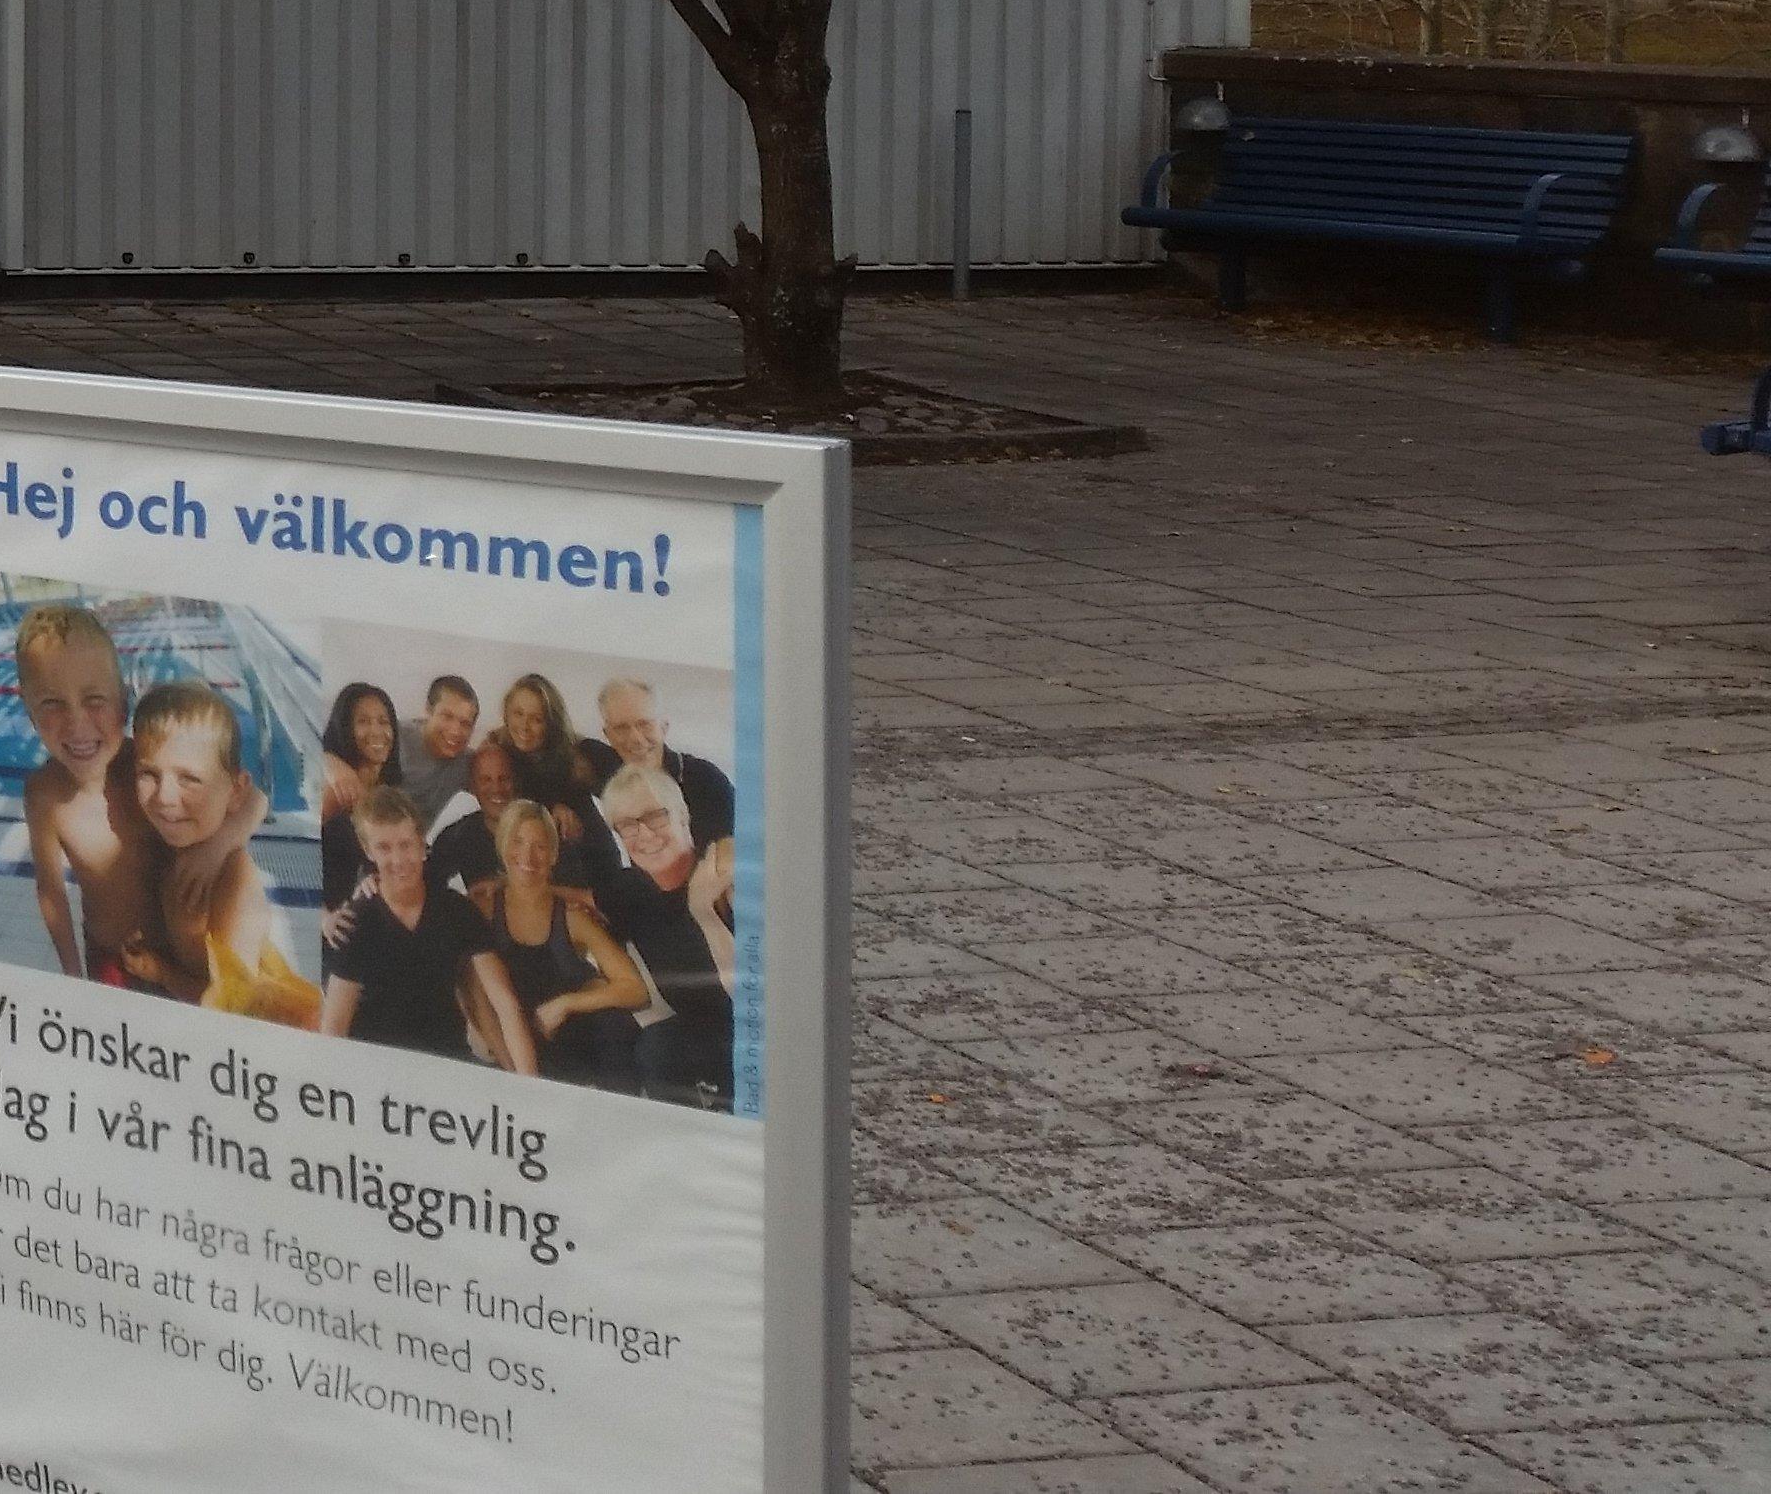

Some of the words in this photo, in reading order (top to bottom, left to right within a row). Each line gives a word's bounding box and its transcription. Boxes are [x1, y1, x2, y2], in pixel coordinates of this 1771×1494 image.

[98, 480, 208, 539] och
[234, 493, 673, 598] välkommen!
[38, 1007, 191, 1083] önskar
[209, 1048, 280, 1124] dig
[298, 1081, 356, 1126] en
[380, 1093, 549, 1183] trevlig
[69, 1090, 77, 1133] i
[97, 1100, 170, 1153] vår
[187, 1114, 273, 1182] fina
[289, 1154, 577, 1266] anläggning.
[13, 1225, 63, 1269] det
[74, 1239, 141, 1290] bara
[153, 1269, 196, 1305] att
[208, 1278, 239, 1314] ta
[253, 1283, 383, 1351] kontakt
[396, 1329, 472, 1374] med
[487, 1356, 557, 1395] oss.
[43, 1177, 82, 1216] du
[96, 1186, 151, 1229] har
[162, 1208, 251, 1259] några
[262, 1228, 363, 1287] frågor
[373, 1261, 452, 1307] eller
[462, 1278, 682, 1365] funderingar
[16, 1278, 87, 1329] finns
[99, 1301, 149, 1345] här
[158, 1320, 207, 1363] för
[218, 1339, 273, 1393] dig.
[288, 1351, 514, 1444] Välkommen!
